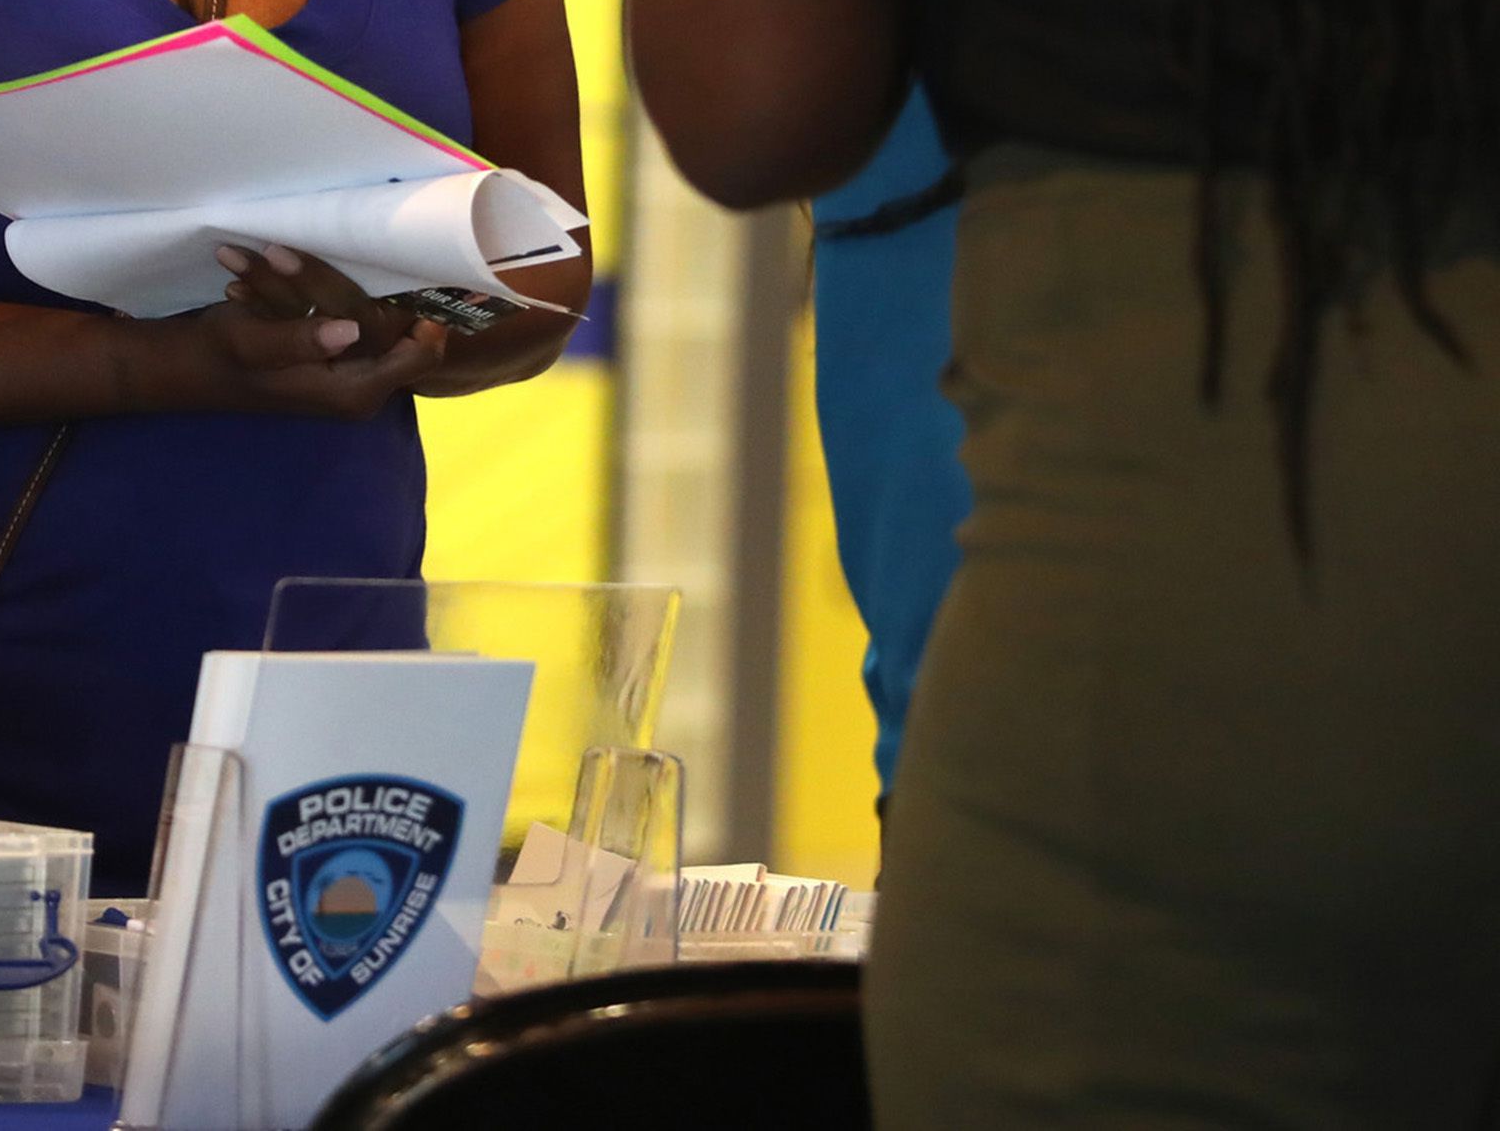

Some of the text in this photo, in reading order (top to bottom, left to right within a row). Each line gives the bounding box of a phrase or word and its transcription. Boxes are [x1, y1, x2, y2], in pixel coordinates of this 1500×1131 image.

[421, 289, 452, 304] OUR
[299, 786, 434, 823] POLICE
[276, 813, 443, 858] DEPARTMENT
[266, 878, 325, 987] CITY OF
[350, 871, 439, 985] SUNRISE
